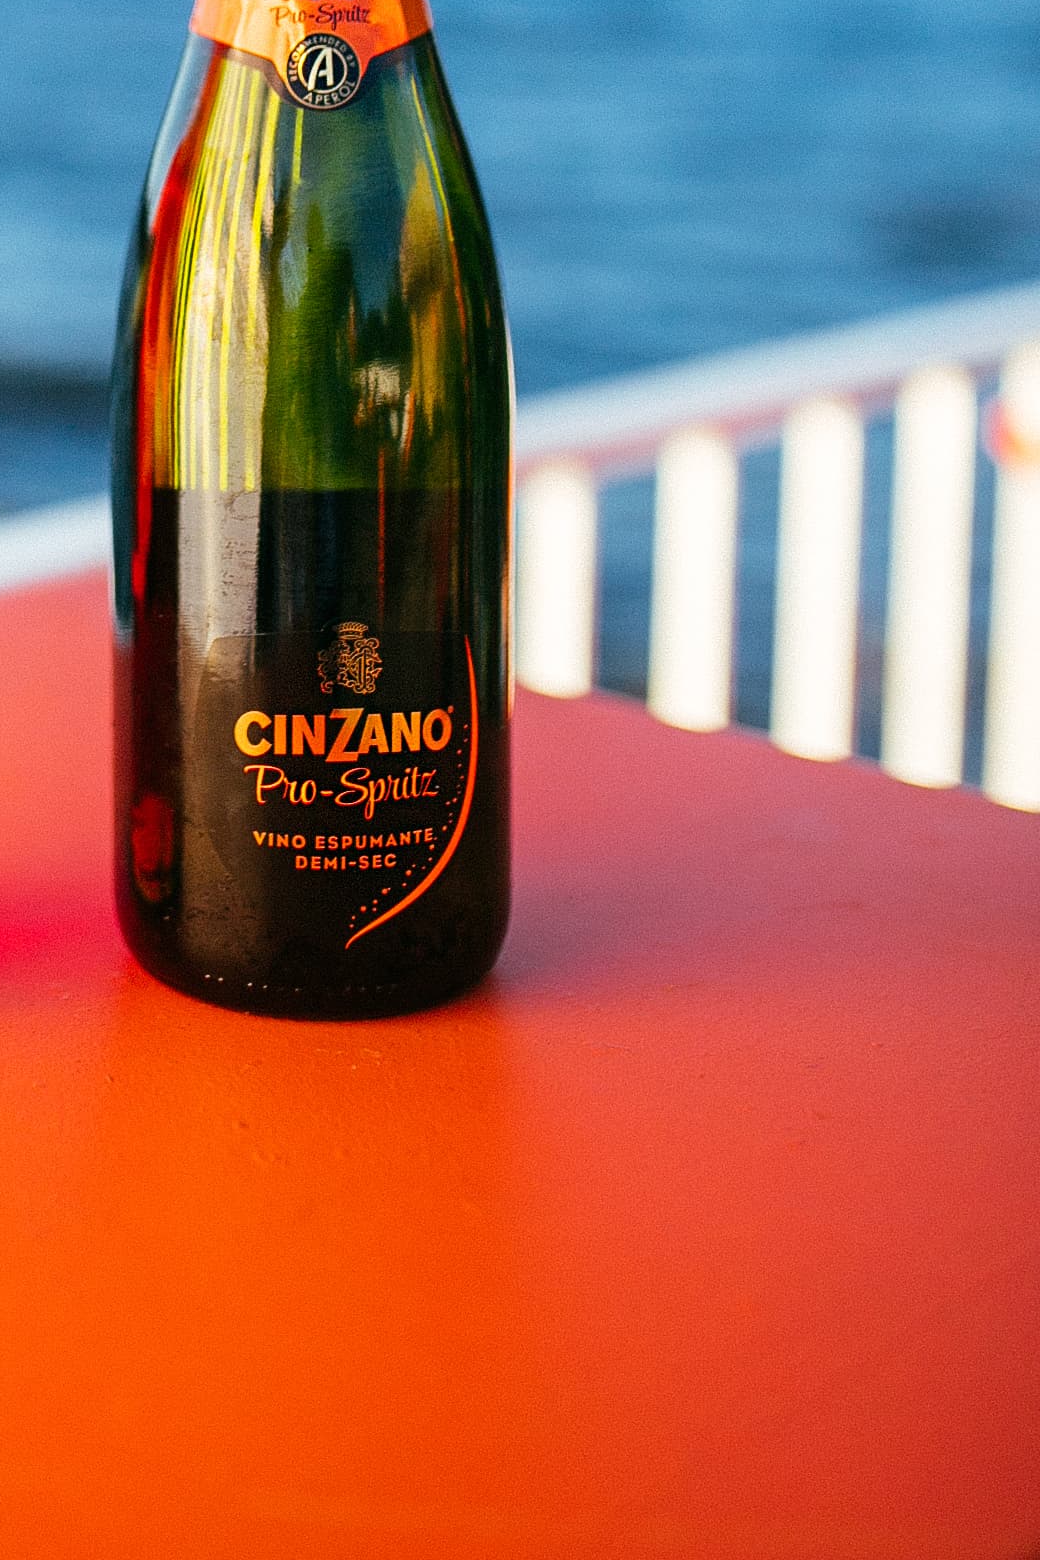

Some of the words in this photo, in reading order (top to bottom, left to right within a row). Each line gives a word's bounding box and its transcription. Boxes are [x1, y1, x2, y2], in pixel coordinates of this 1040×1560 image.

[270, 3, 372, 31] Pro-Spritz
[307, 46, 335, 92] A
[303, 80, 356, 106] APEROL
[234, 707, 453, 763] CINZANO
[243, 764, 439, 820] Pro-Spritz
[252, 830, 307, 849] VINO
[315, 827, 434, 850] ESPUMANTE
[295, 853, 397, 871] DEMI-SEC
